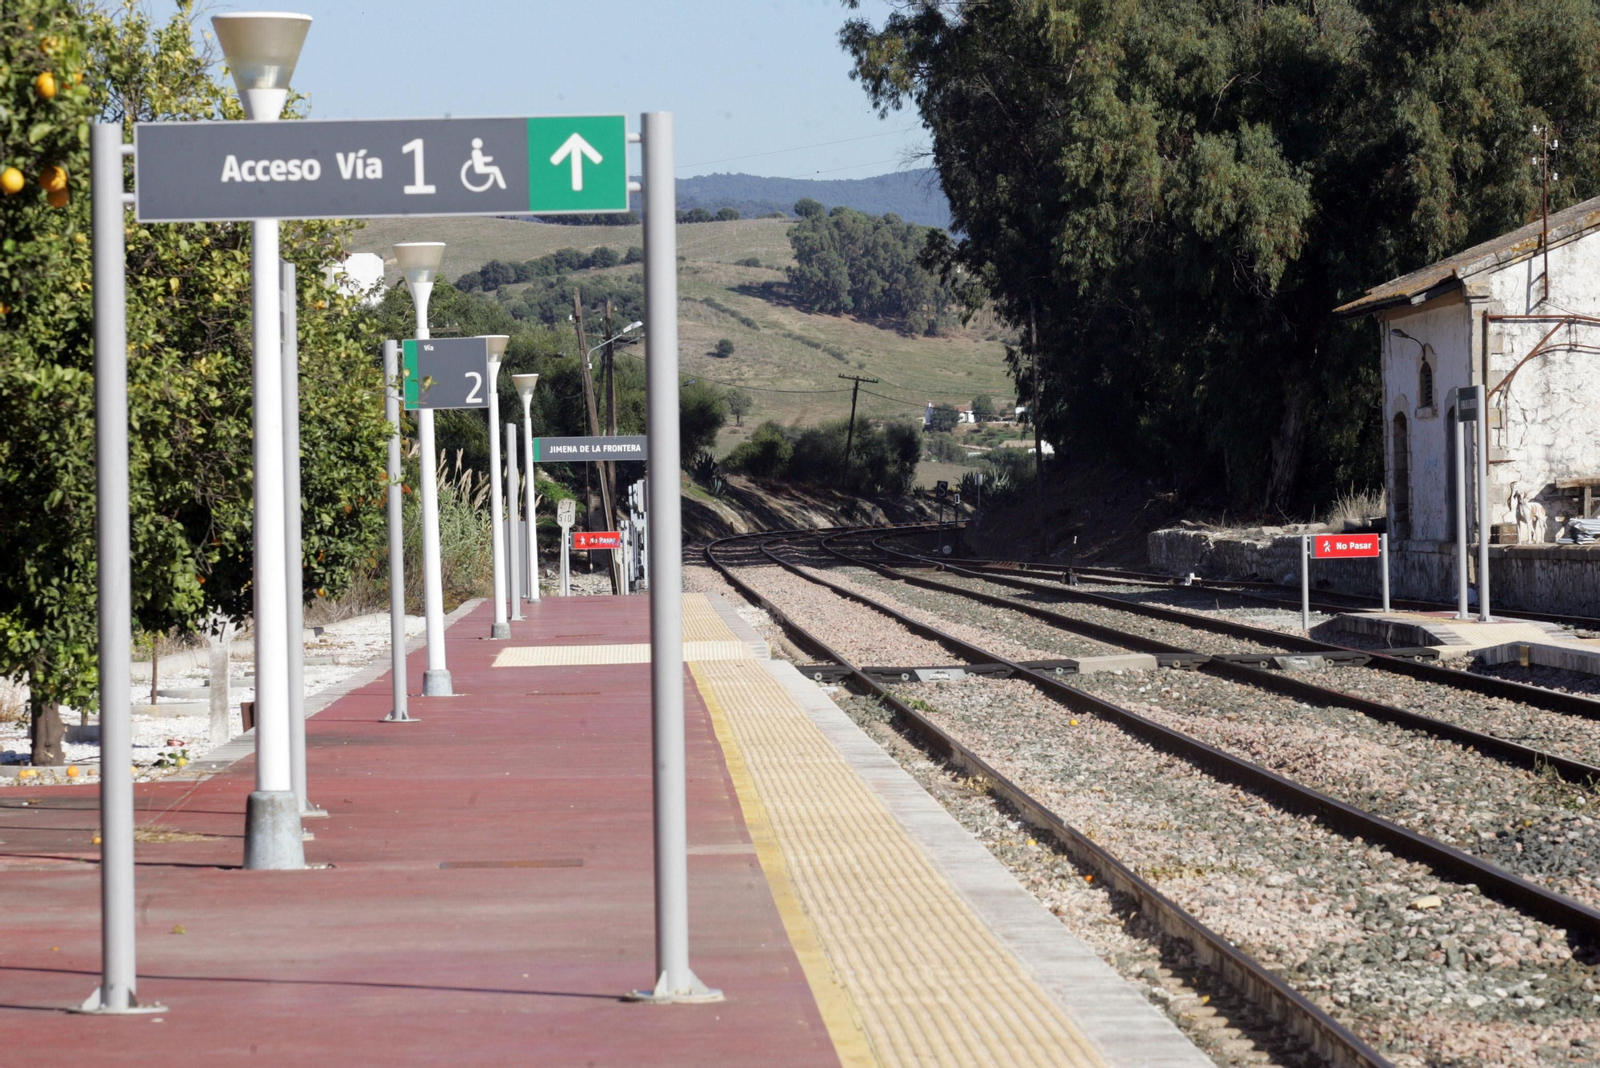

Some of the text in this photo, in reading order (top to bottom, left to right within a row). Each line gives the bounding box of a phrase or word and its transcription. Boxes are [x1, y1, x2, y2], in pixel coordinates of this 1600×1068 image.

[221, 138, 436, 194] Acceso Vía 1
[465, 372, 482, 403] 2
[549, 444, 641, 454] JIMENA DE LA FRONTERA
[1336, 542, 1372, 550] No Pasar
